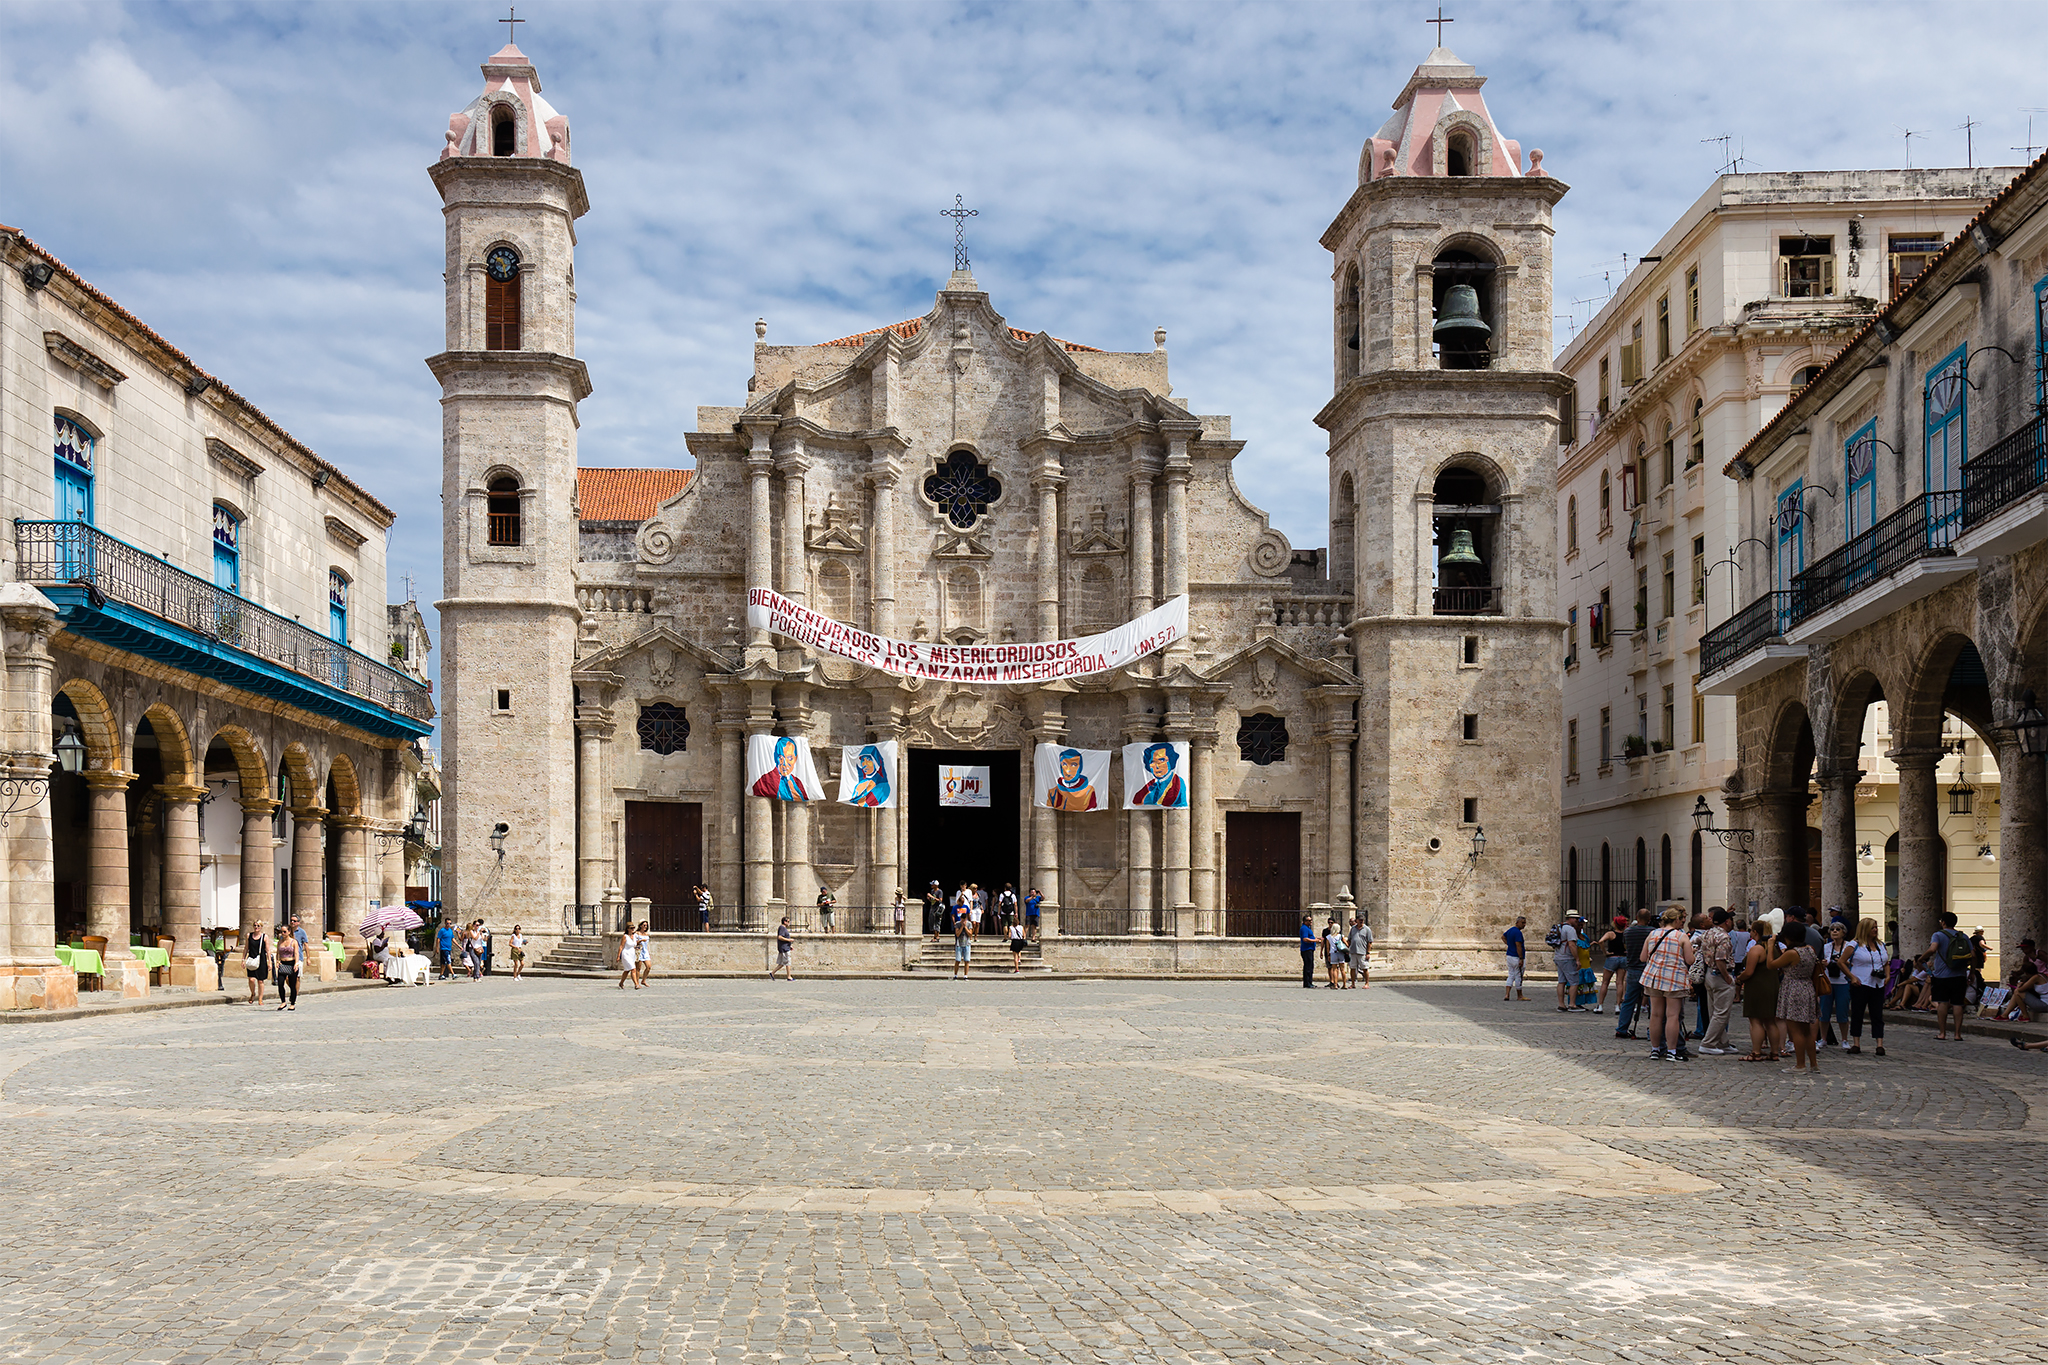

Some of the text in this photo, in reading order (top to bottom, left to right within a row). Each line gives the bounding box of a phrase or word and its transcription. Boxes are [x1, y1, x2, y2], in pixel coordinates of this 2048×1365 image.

[749, 588, 880, 653] BIENAVENTURADOS
[886, 639, 919, 661] LOS
[769, 611, 827, 649] PORQUE
[828, 640, 876, 666] ELLOS
[882, 657, 998, 681] ALCANZARÁN
[1134, 636, 1156, 657] (Mt
[960, 779, 980, 794] JMJ
